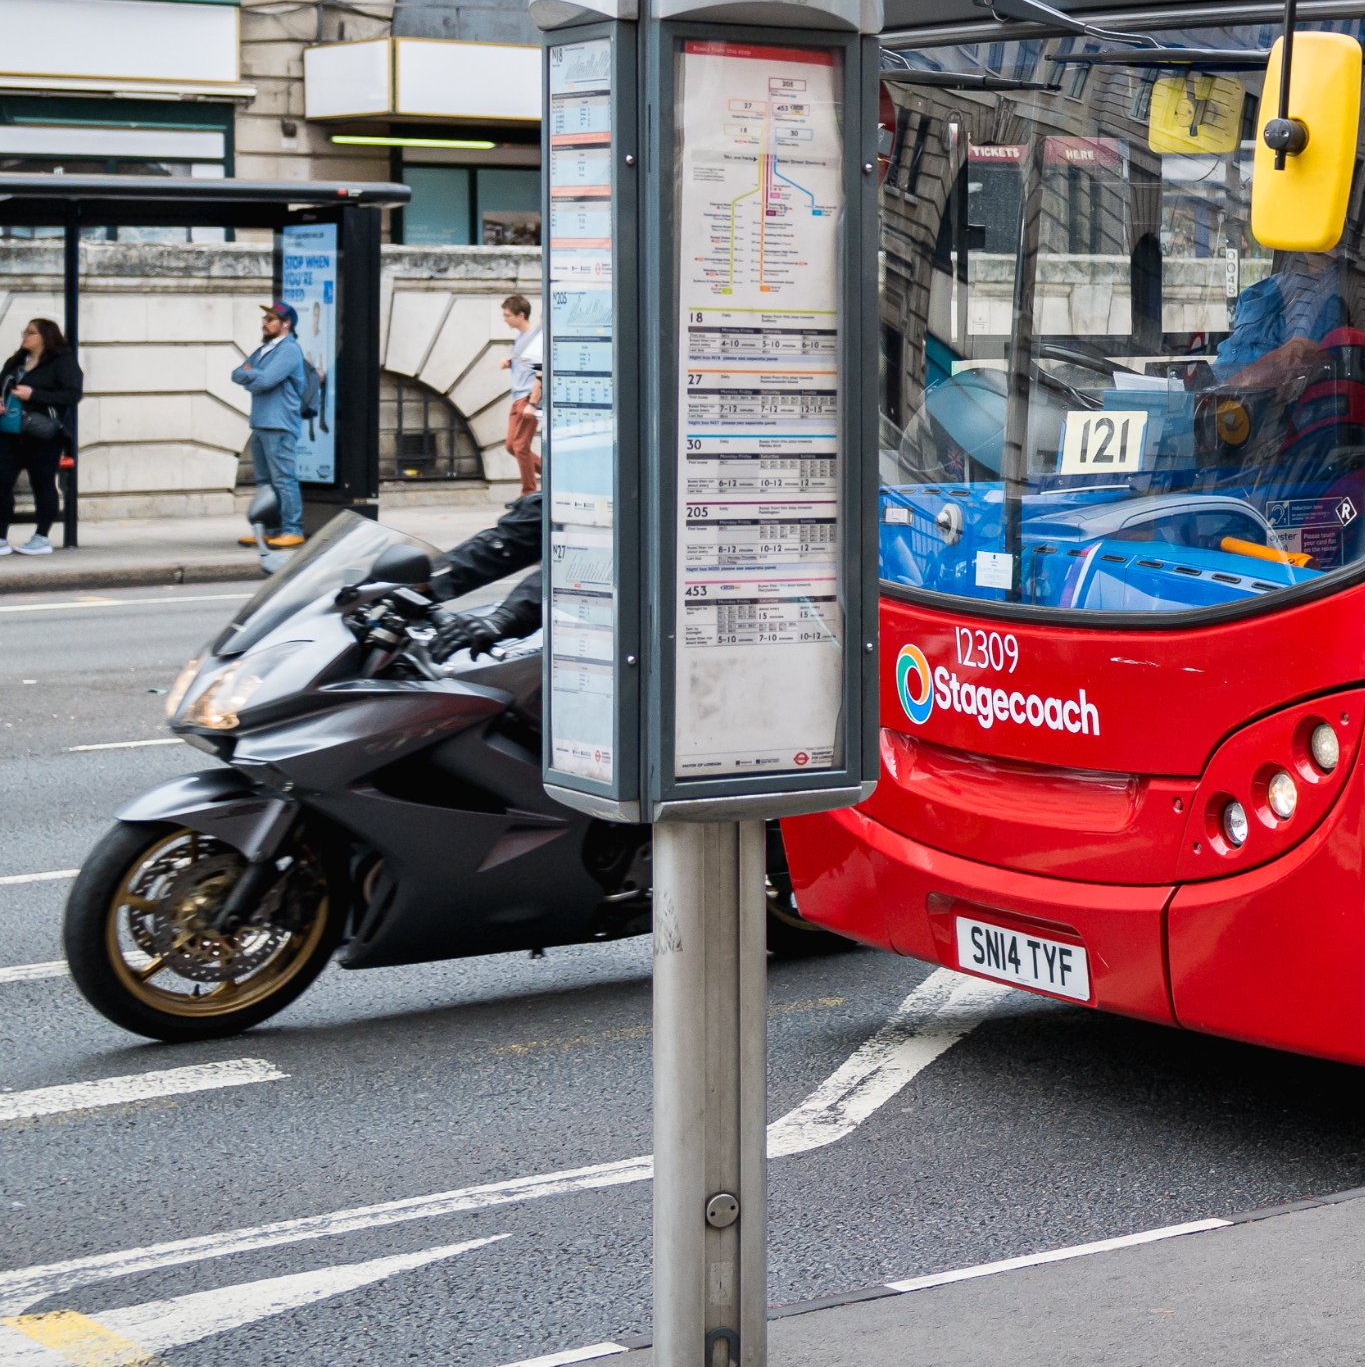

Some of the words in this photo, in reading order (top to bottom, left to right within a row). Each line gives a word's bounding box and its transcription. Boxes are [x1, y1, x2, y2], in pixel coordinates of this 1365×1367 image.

[971, 146, 1020, 158] TICKETS
[1065, 149, 1095, 160] HERE
[690, 312, 703, 323] 18
[688, 374, 702, 385] 27
[687, 439, 701, 450] 30
[1079, 418, 1129, 465] 121
[687, 507, 708, 518] 205
[1341, 503, 1351, 520] R
[685, 585, 707, 596] 453
[955, 626, 1020, 674] 12309
[934, 665, 1101, 736] Stagecoach
[972, 926, 1022, 974] SN14
[1027, 937, 1073, 987] TYF
